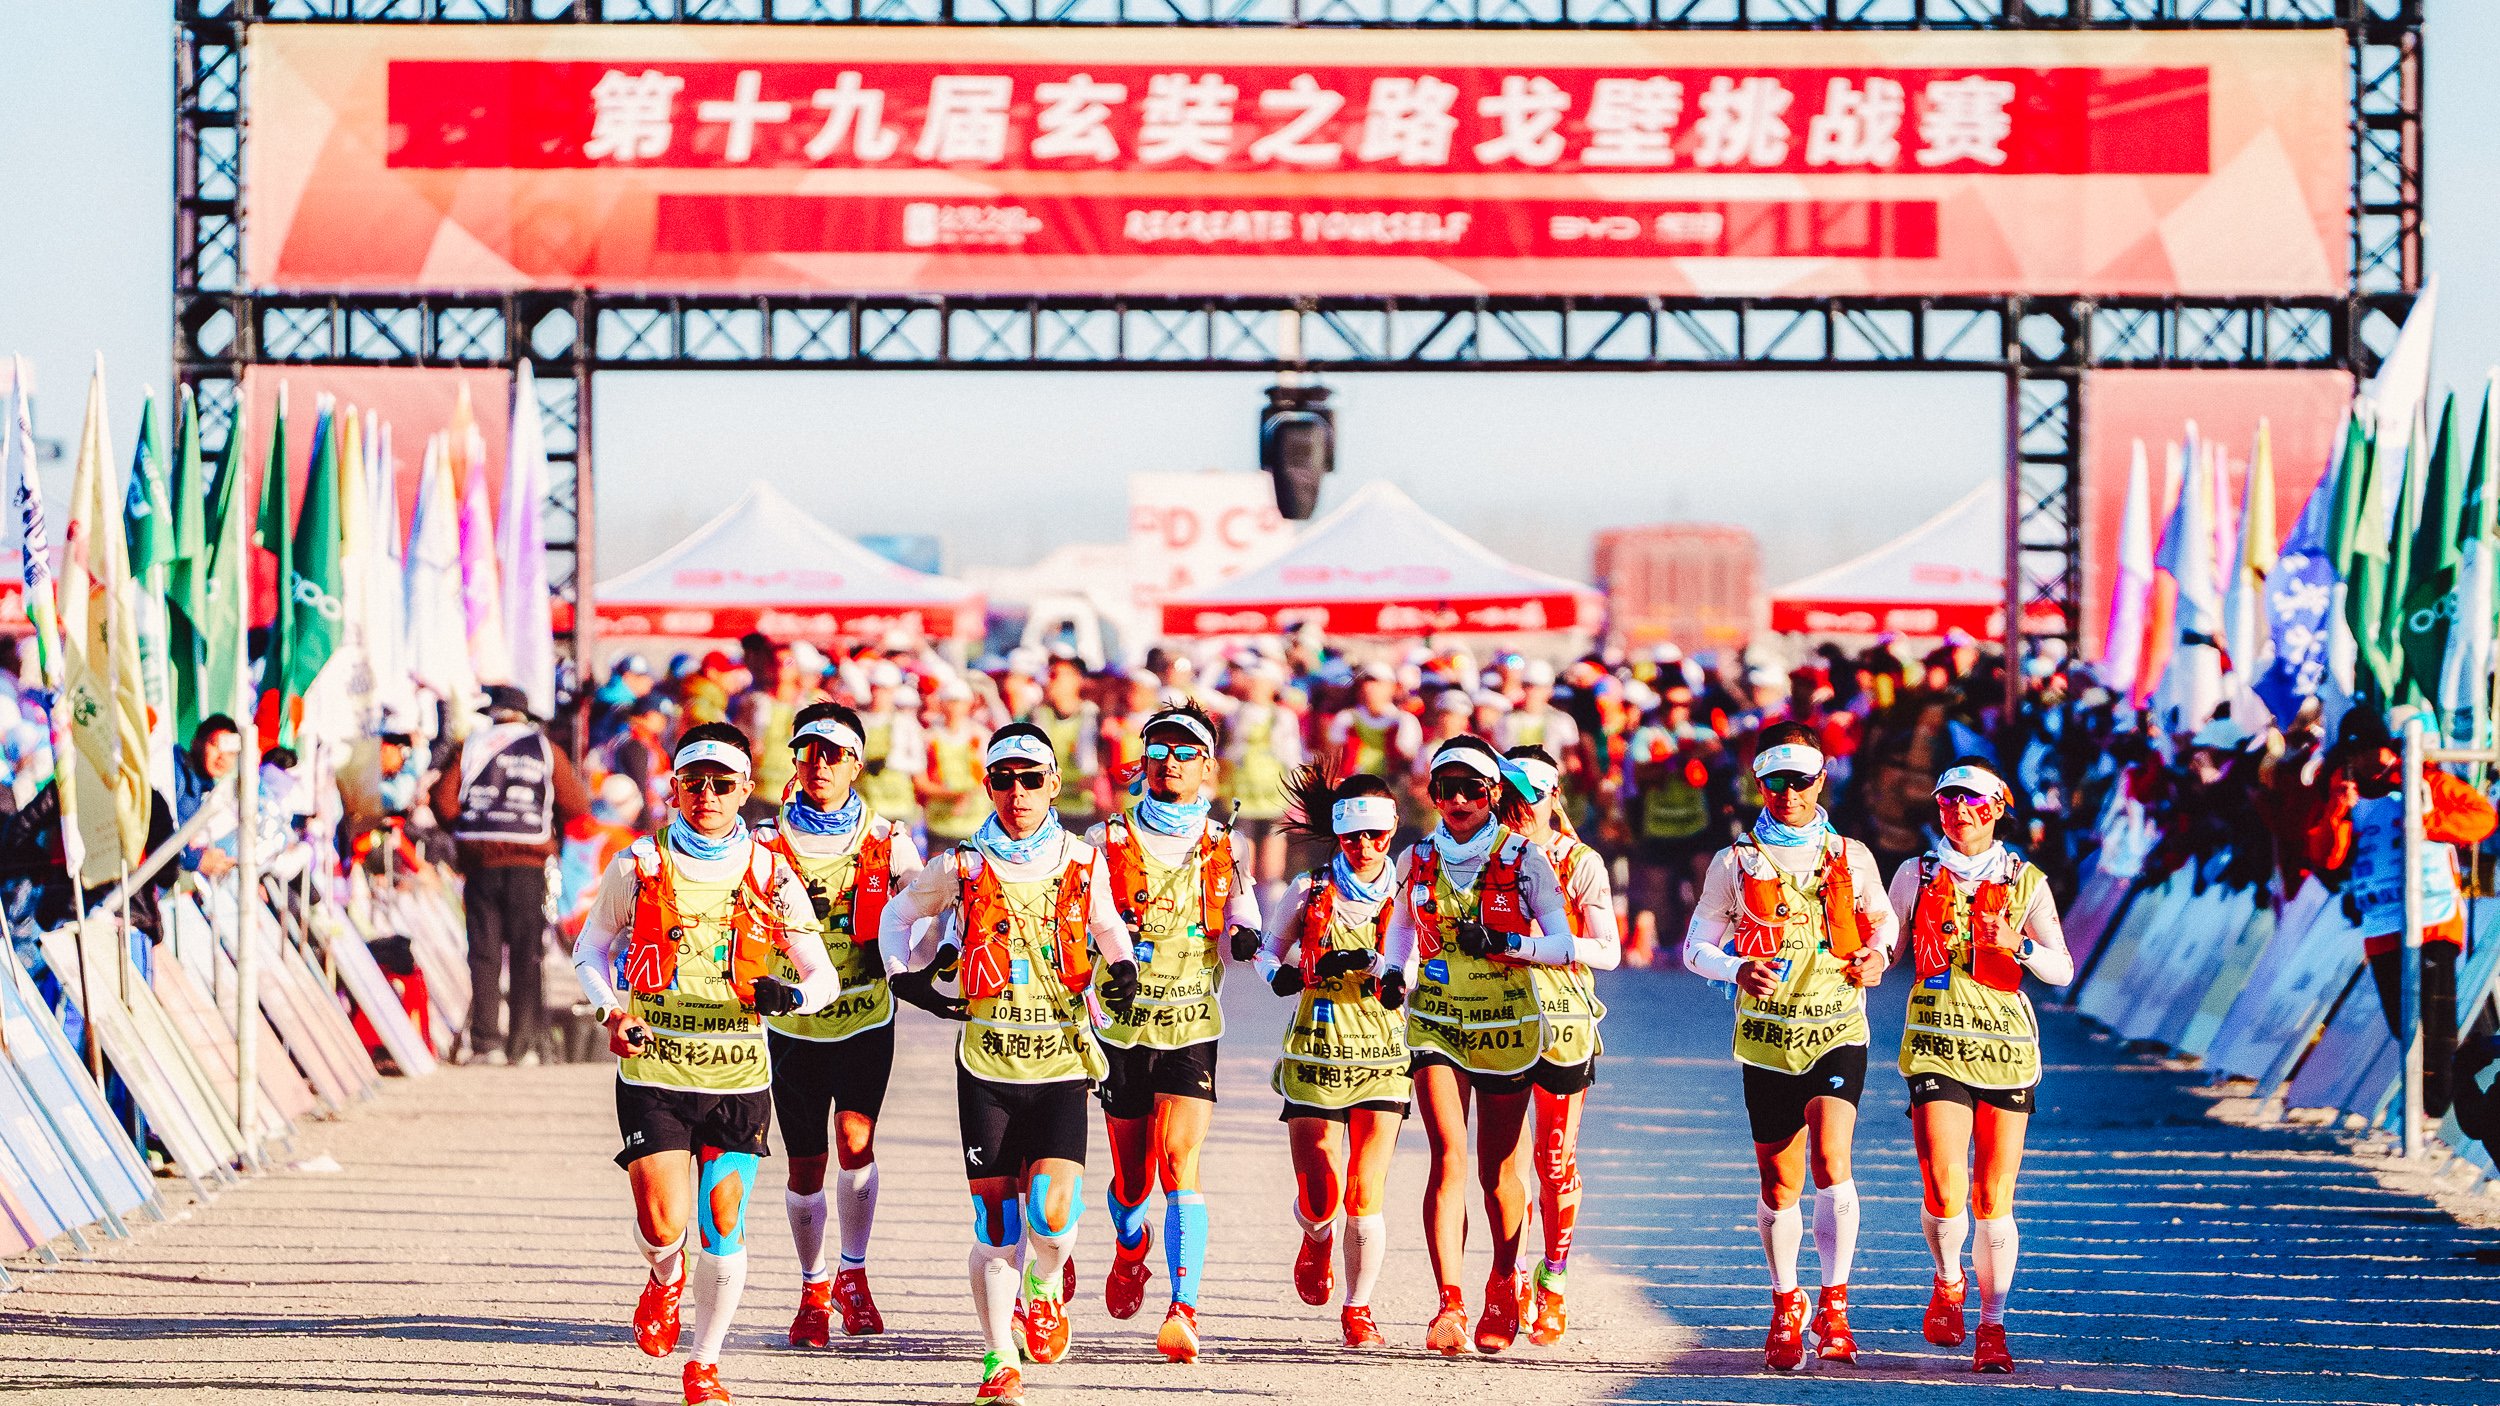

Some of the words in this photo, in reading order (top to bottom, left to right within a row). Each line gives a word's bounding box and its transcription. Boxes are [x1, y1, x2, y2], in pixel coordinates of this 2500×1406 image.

[585, 69, 2015, 167] 第十九届玄奘之路戈壁挑战赛
[1124, 210, 1293, 242] RECREATE
[1301, 211, 1471, 243] YOURSELF
[644, 1010, 749, 1032] 10月3日-MBA组
[1304, 1042, 1401, 1059] 10月3日-MBA组
